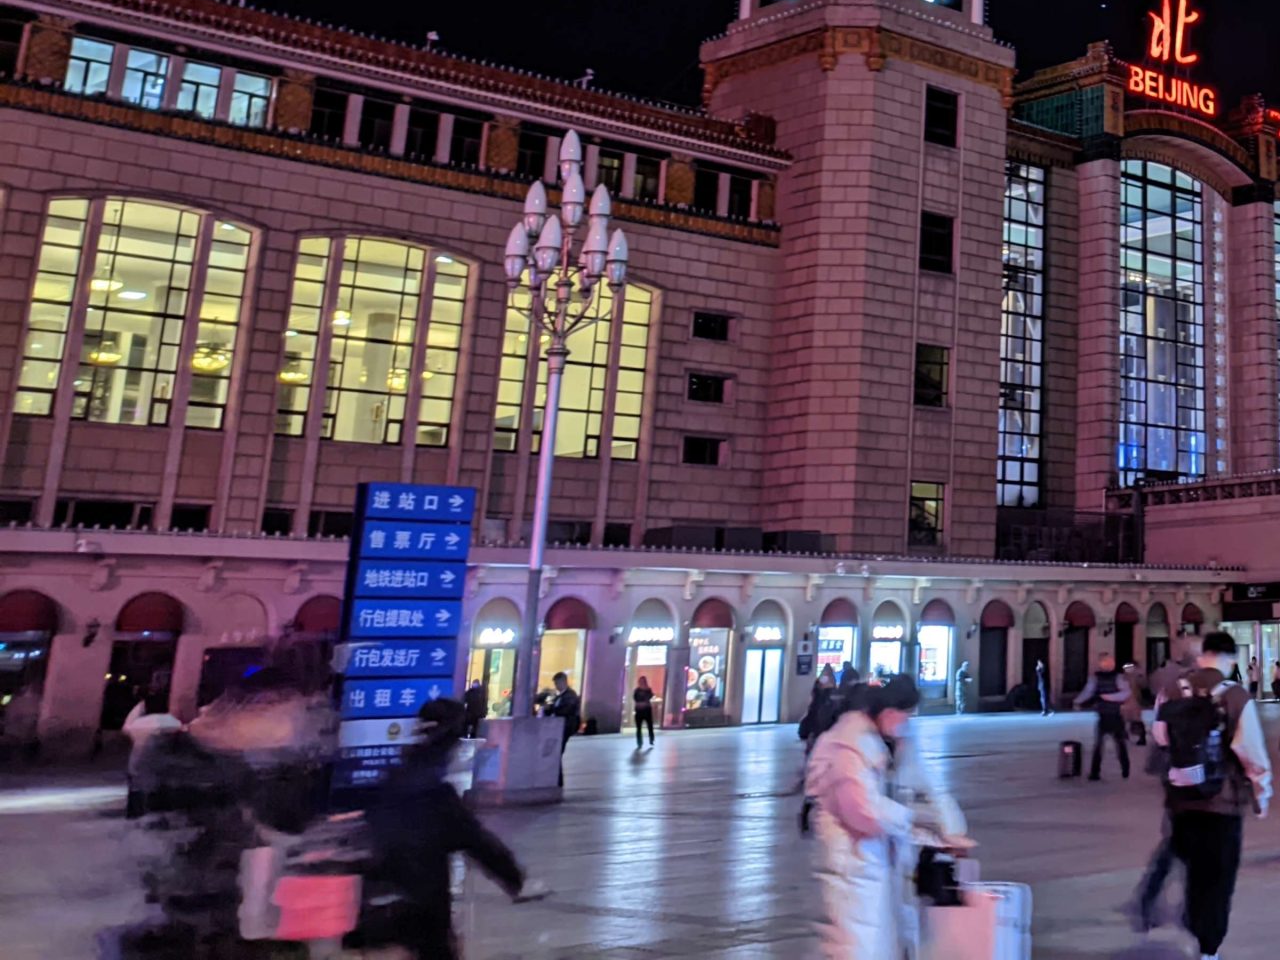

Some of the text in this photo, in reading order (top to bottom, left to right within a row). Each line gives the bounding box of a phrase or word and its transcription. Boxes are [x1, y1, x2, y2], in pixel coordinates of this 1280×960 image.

[1129, 65, 1215, 115] BEIJING
[372, 490, 439, 511] 进站口
[369, 529, 436, 550] 售票厅
[364, 568, 429, 588] 地铁进站口
[359, 608, 424, 628] 行包提取处
[354, 648, 420, 667] 行包发送厅
[350, 687, 417, 708] 出租车
